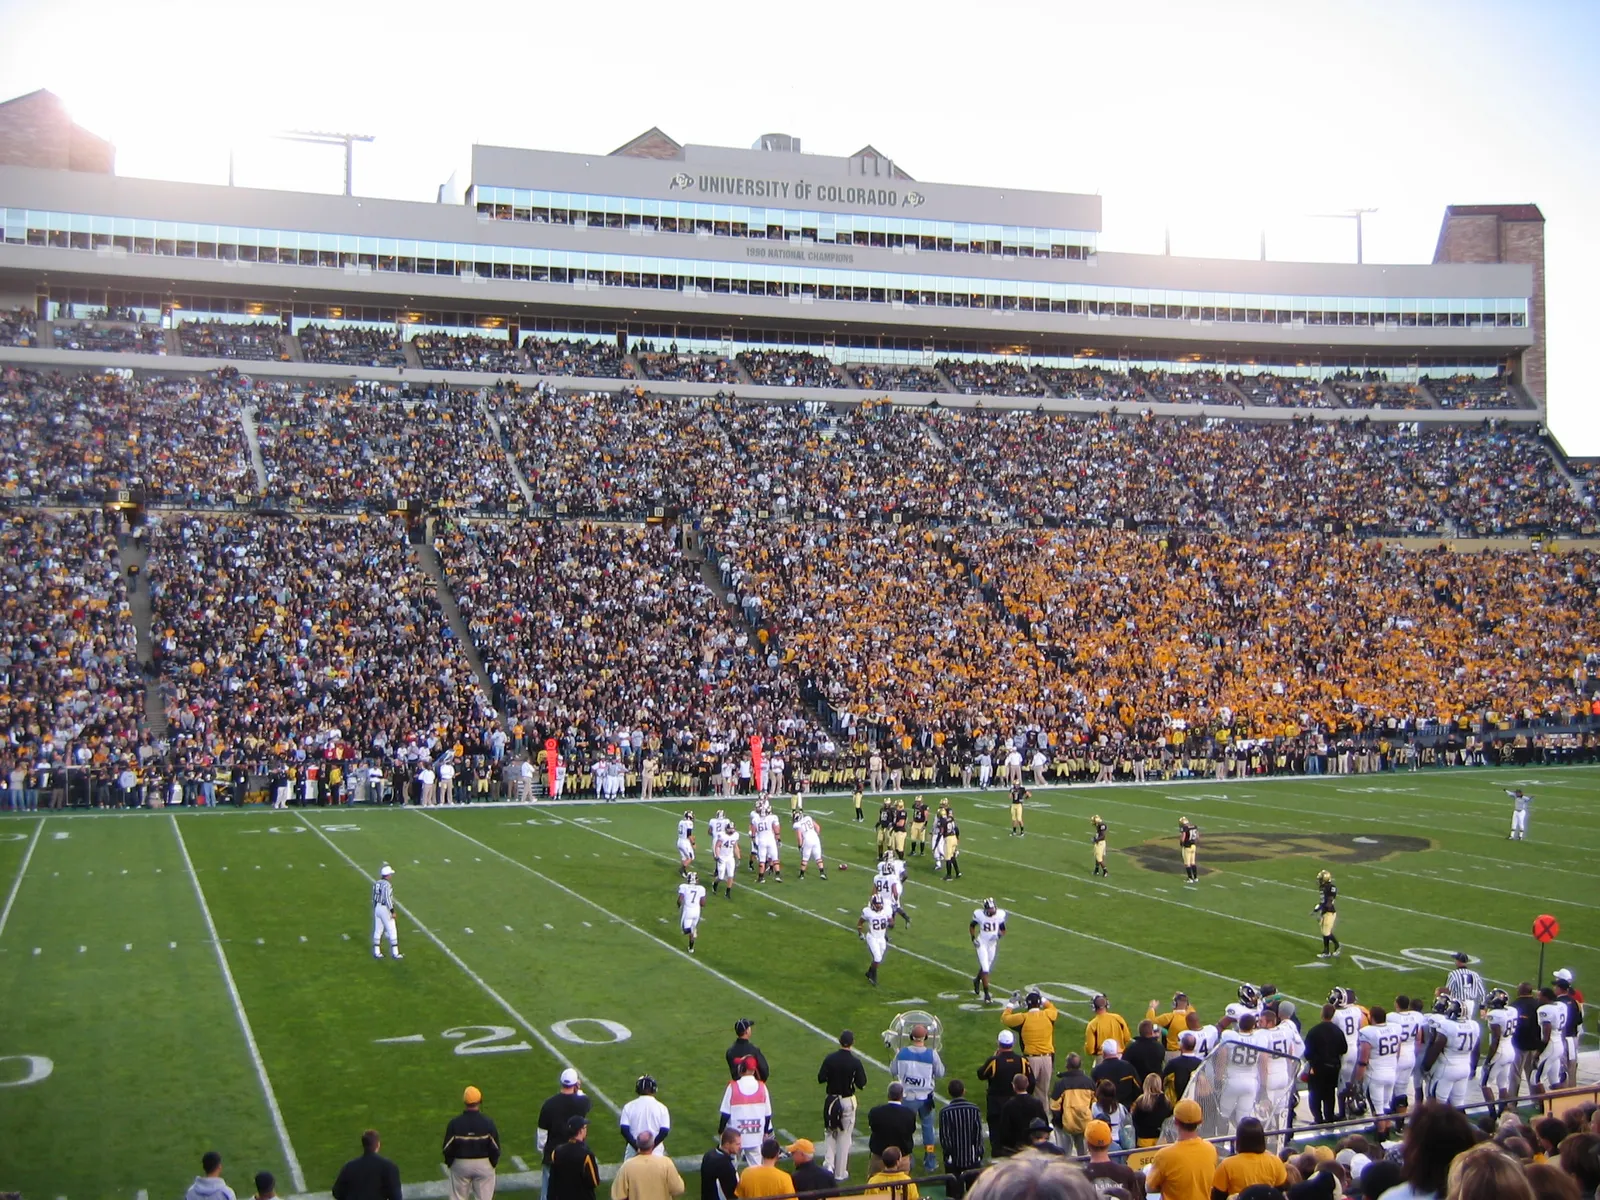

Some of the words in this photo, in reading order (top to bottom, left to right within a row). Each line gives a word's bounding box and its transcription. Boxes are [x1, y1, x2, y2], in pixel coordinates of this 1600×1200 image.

[699, 175, 790, 199] UNIVERSITY
[795, 183, 812, 200] OF
[817, 185, 898, 207] COLORADO
[746, 247, 766, 257] 1990
[768, 248, 805, 260] NATIONAL
[807, 251, 855, 264] CHAMPIONS
[757, 821, 769, 833] 61
[801, 820, 814, 833] 78
[1188, 829, 1197, 841] 15
[876, 880, 889, 893] 84
[690, 890, 697, 904] 7
[872, 918, 888, 931] 28
[983, 922, 997, 933] 81
[1350, 947, 1481, 972] 40
[1344, 1016, 1355, 1036] 8
[1400, 1023, 1419, 1043] 54
[441, 1018, 632, 1055] 20
[1379, 1034, 1399, 1056] 62
[1457, 1031, 1474, 1051] 71
[1232, 1044, 1258, 1067] 68
[904, 1076, 922, 1087] FSN
